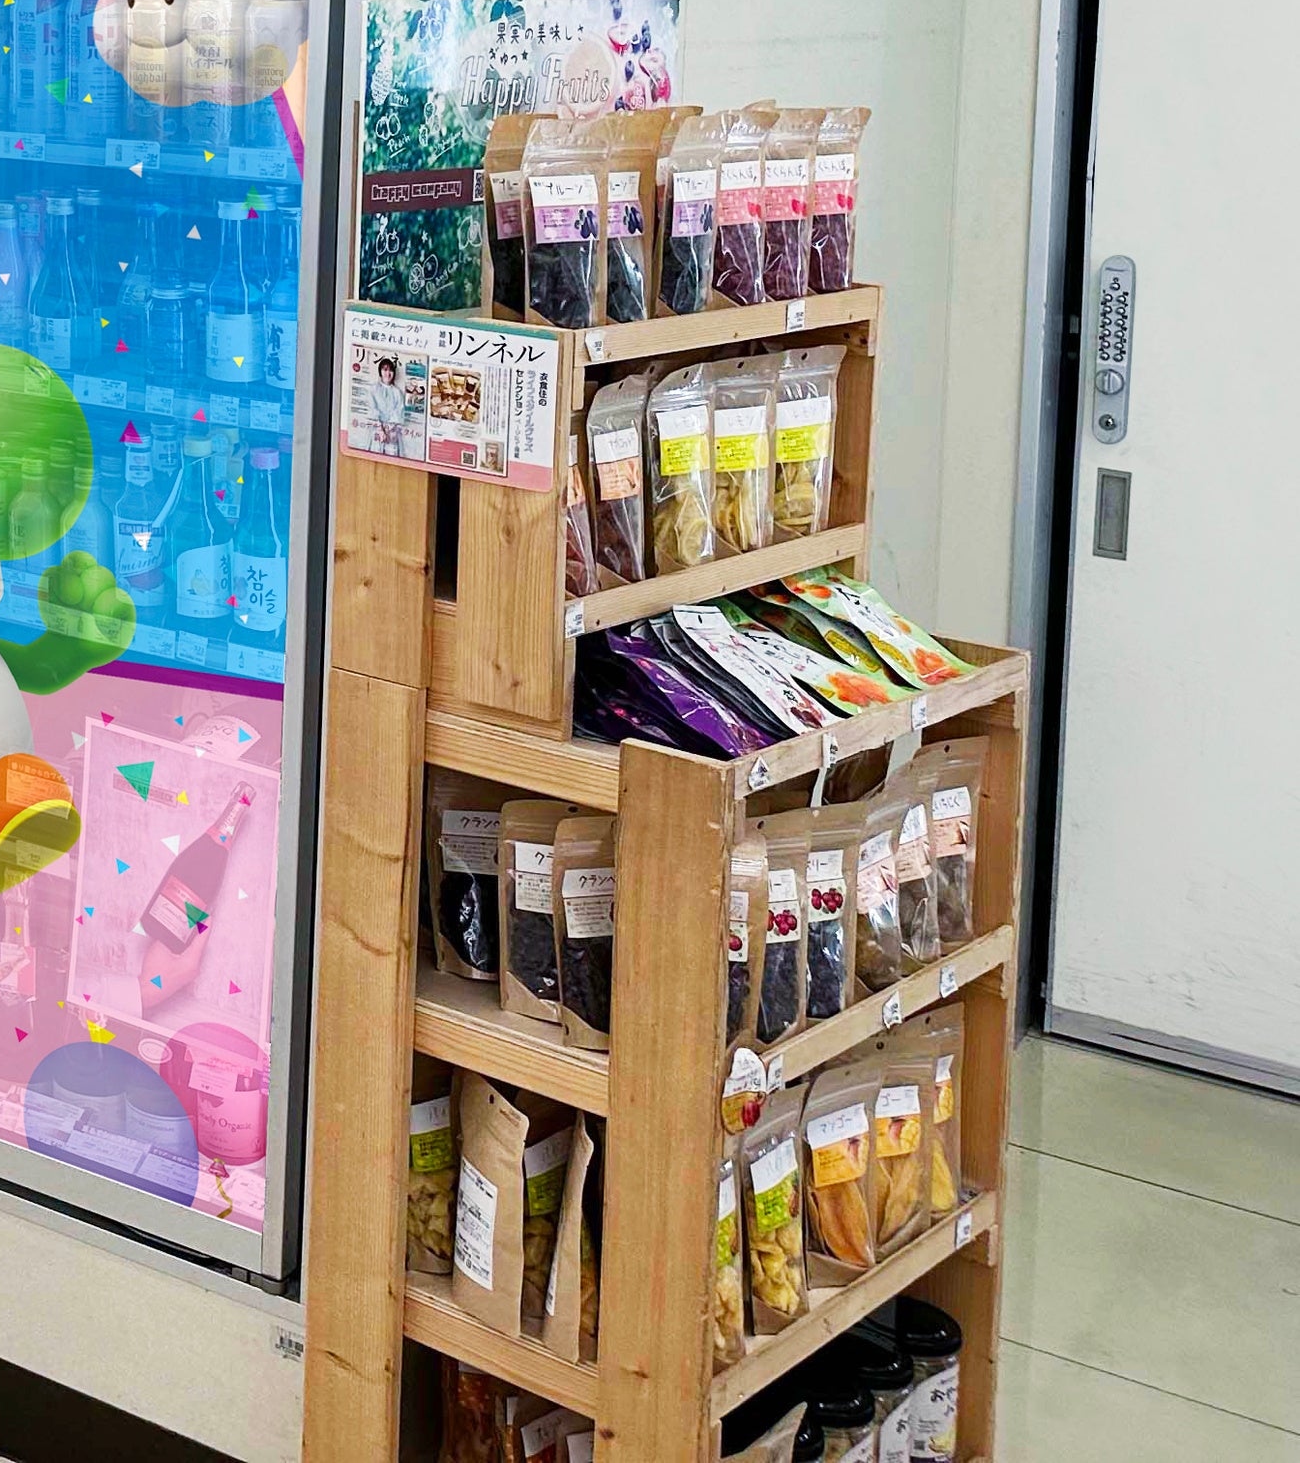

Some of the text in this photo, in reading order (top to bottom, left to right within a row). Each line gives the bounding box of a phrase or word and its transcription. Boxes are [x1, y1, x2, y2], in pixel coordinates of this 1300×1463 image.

[497, 22, 585, 44] 果実の美味しさ
[460, 51, 611, 115] Happy Fruits
[371, 180, 462, 203] happy company
[352, 316, 424, 334] ハッピーフルーツが
[448, 330, 546, 365] リンネル
[538, 372, 549, 407] 衣食住の
